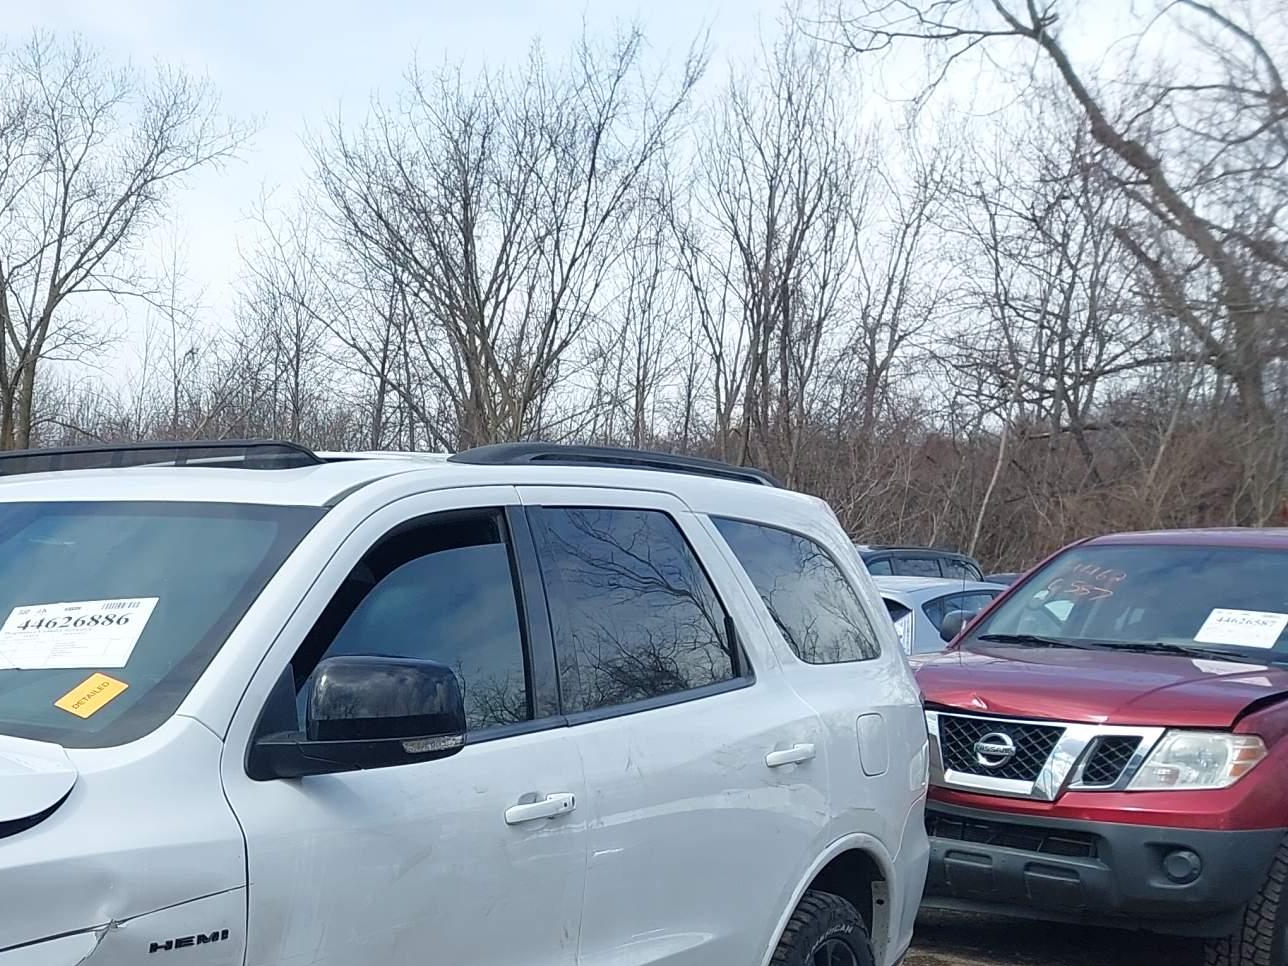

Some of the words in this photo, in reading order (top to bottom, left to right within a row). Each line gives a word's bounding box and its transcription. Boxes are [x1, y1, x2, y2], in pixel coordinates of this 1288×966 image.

[17, 612, 134, 631] 44626886
[71, 680, 110, 710] DETAILED
[148, 929, 230, 953] HEMI
[804, 923, 854, 965] ICAN
